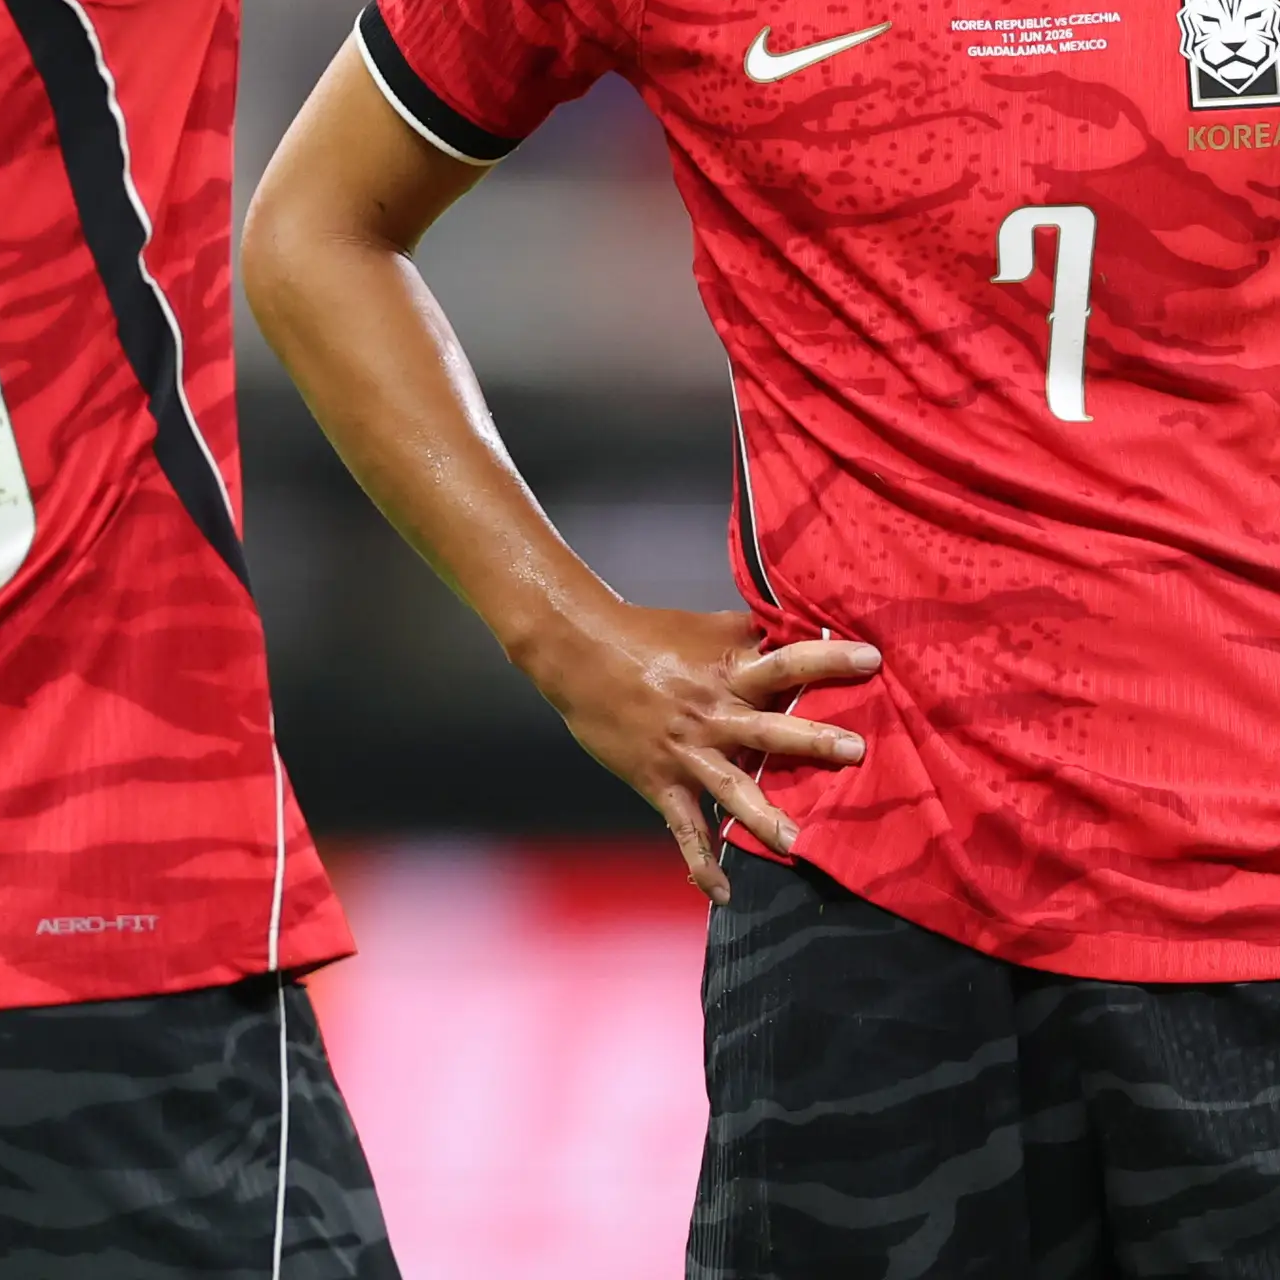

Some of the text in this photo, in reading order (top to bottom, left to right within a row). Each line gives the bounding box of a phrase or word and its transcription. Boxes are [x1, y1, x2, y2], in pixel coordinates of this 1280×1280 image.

[951, 19, 992, 31] KOREA
[995, 17, 1052, 30] REPUBLIC
[1069, 12, 1121, 25] CZECHIA
[1002, 29, 1073, 43] 11 JUN 2026
[967, 39, 1107, 57] GUADALAJARA, MEXICO
[990, 204, 1097, 422] 7
[36, 914, 159, 936] AERO-FIT
